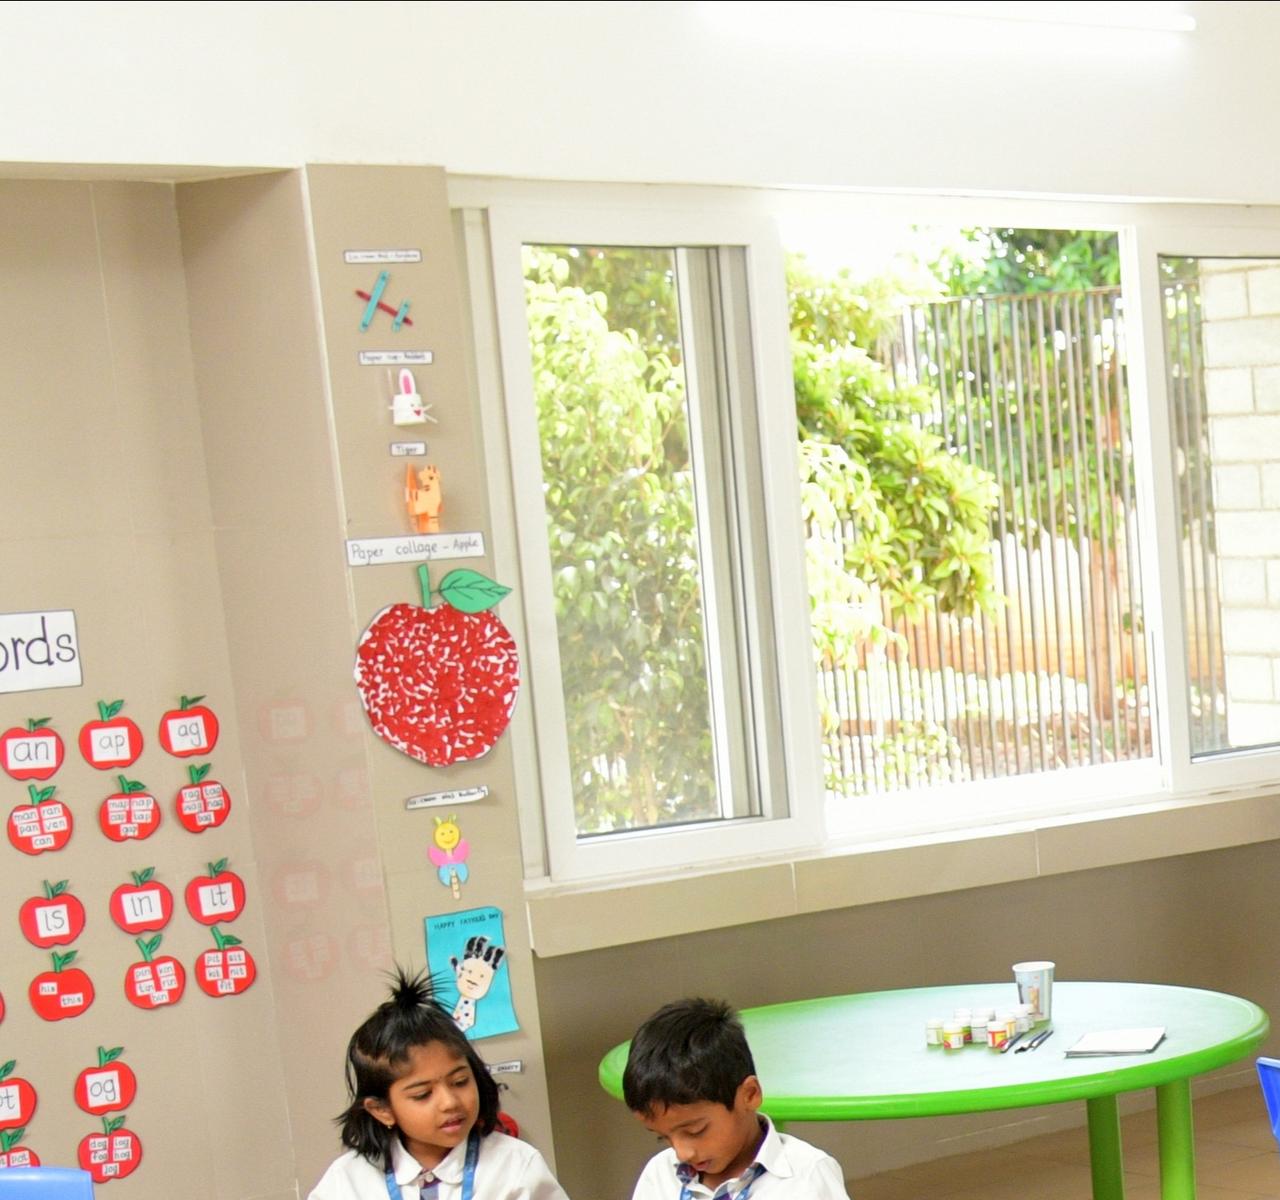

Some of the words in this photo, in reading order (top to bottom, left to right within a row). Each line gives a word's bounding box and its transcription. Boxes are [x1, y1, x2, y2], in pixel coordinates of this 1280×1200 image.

[351, 543, 384, 566] Paper
[396, 540, 437, 560] collage
[453, 538, 479, 553] Apple
[177, 720, 202, 747] ag
[13, 741, 49, 762] an
[99, 732, 126, 757] ap
[14, 810, 37, 822] man
[42, 805, 61, 817] ran
[132, 798, 153, 810] nap
[19, 822, 40, 834] pan
[34, 836, 53, 847] can
[131, 894, 152, 916] in
[210, 885, 228, 907] it
[44, 908, 66, 931] is
[206, 952, 221, 965] pit
[135, 967, 151, 979] pin
[89, 1078, 117, 1102] og
[90, 1137, 107, 1150] dog
